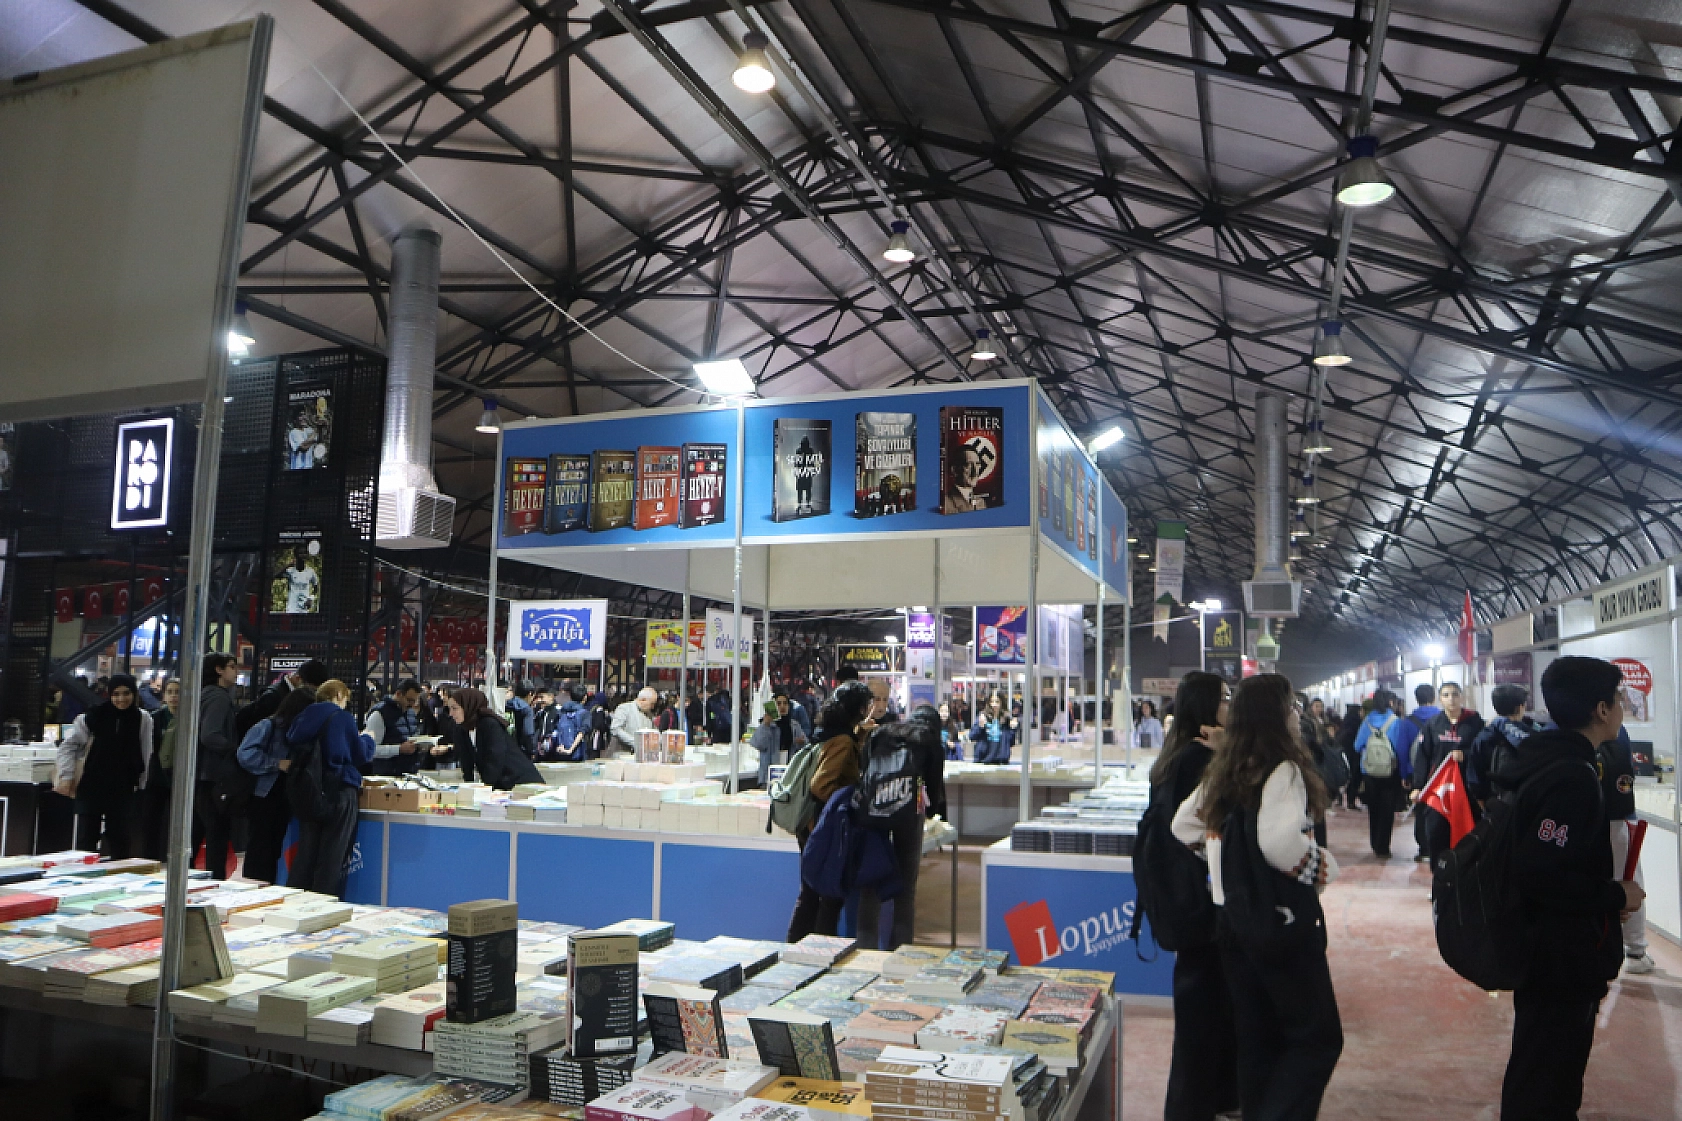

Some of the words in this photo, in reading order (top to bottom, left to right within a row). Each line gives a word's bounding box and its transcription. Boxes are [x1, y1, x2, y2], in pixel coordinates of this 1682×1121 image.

[950, 414, 1001, 430] HİTLER
[1537, 818, 1569, 848] 84
[1034, 899, 1136, 962] Lopus
